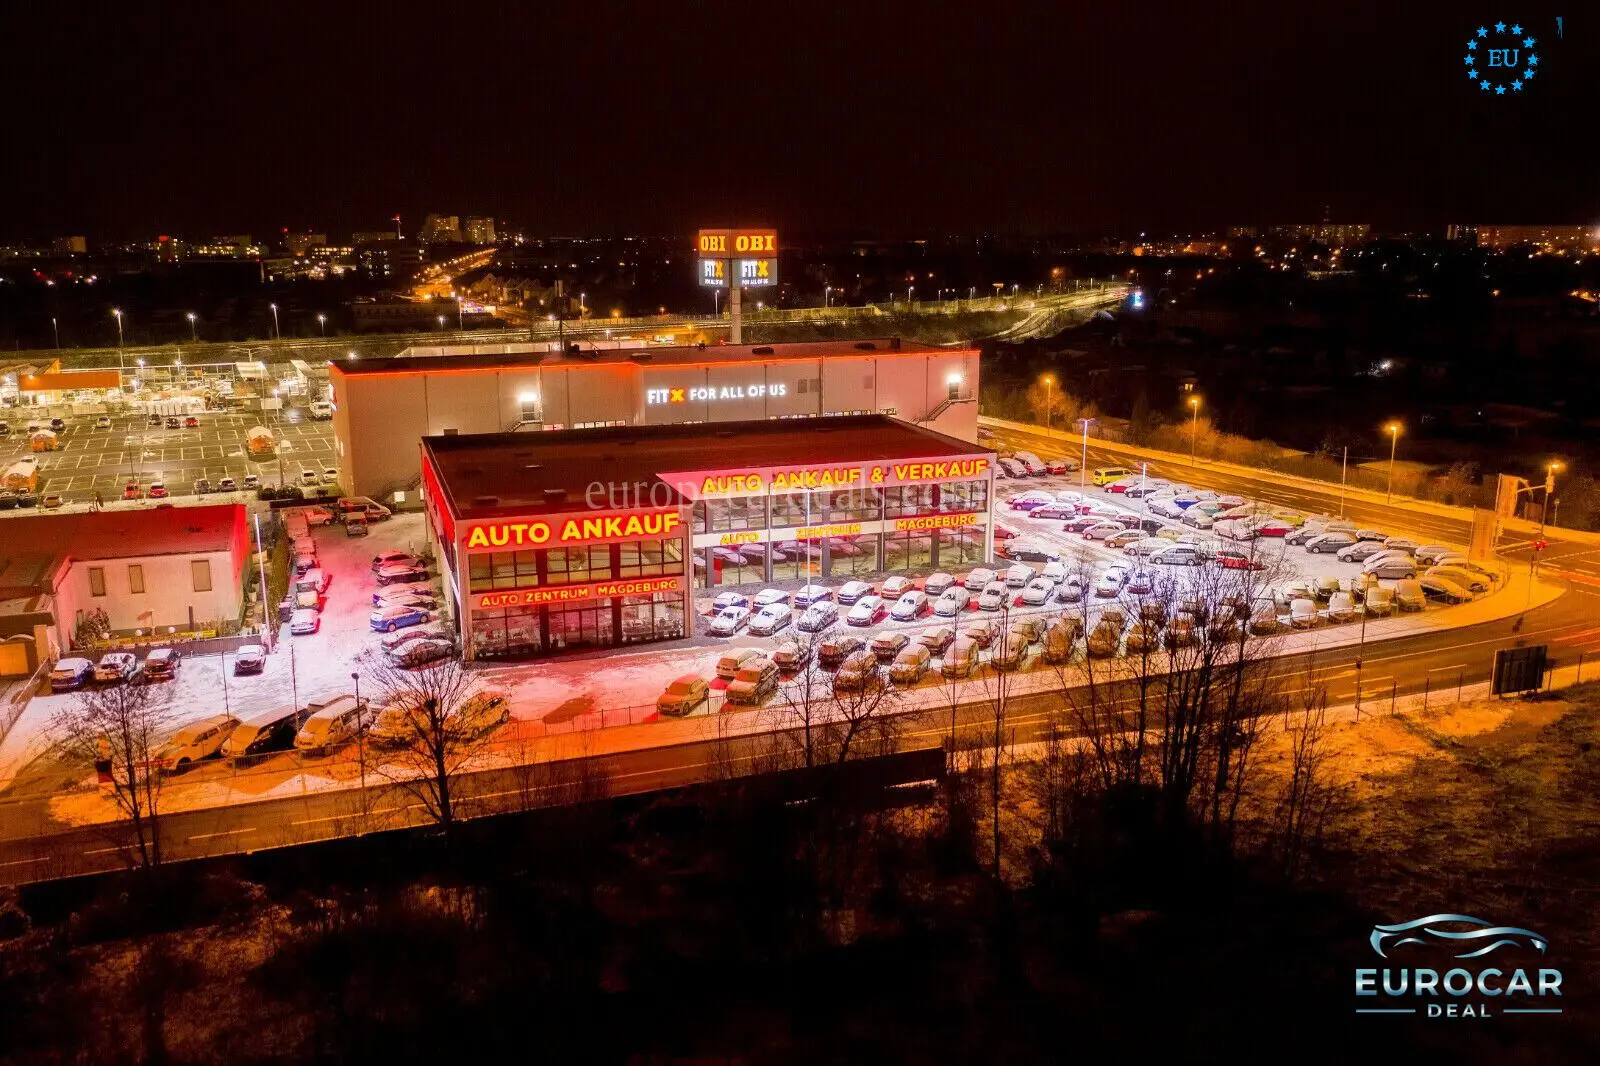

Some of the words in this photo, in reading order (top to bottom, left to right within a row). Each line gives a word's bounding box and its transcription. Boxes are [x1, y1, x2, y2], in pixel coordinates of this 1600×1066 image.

[700, 236, 726, 252] OBI
[735, 236, 775, 252] OBI
[690, 388, 717, 400] FOR
[720, 387, 744, 399] ALL
[748, 385, 766, 397] OF
[769, 384, 786, 396] US
[701, 474, 763, 494] AUTO
[773, 467, 862, 489] ANKAUF
[869, 466, 885, 483] &
[893, 458, 990, 481] VERKAUF
[467, 521, 551, 548] AUTO
[561, 512, 681, 542] ANKAUF
[719, 532, 760, 546] AUTO
[896, 514, 977, 531] MAGDEBURG
[480, 595, 519, 607] AUTO
[525, 587, 589, 603] ZENTRUM
[597, 579, 679, 596] MAGDEBURG
